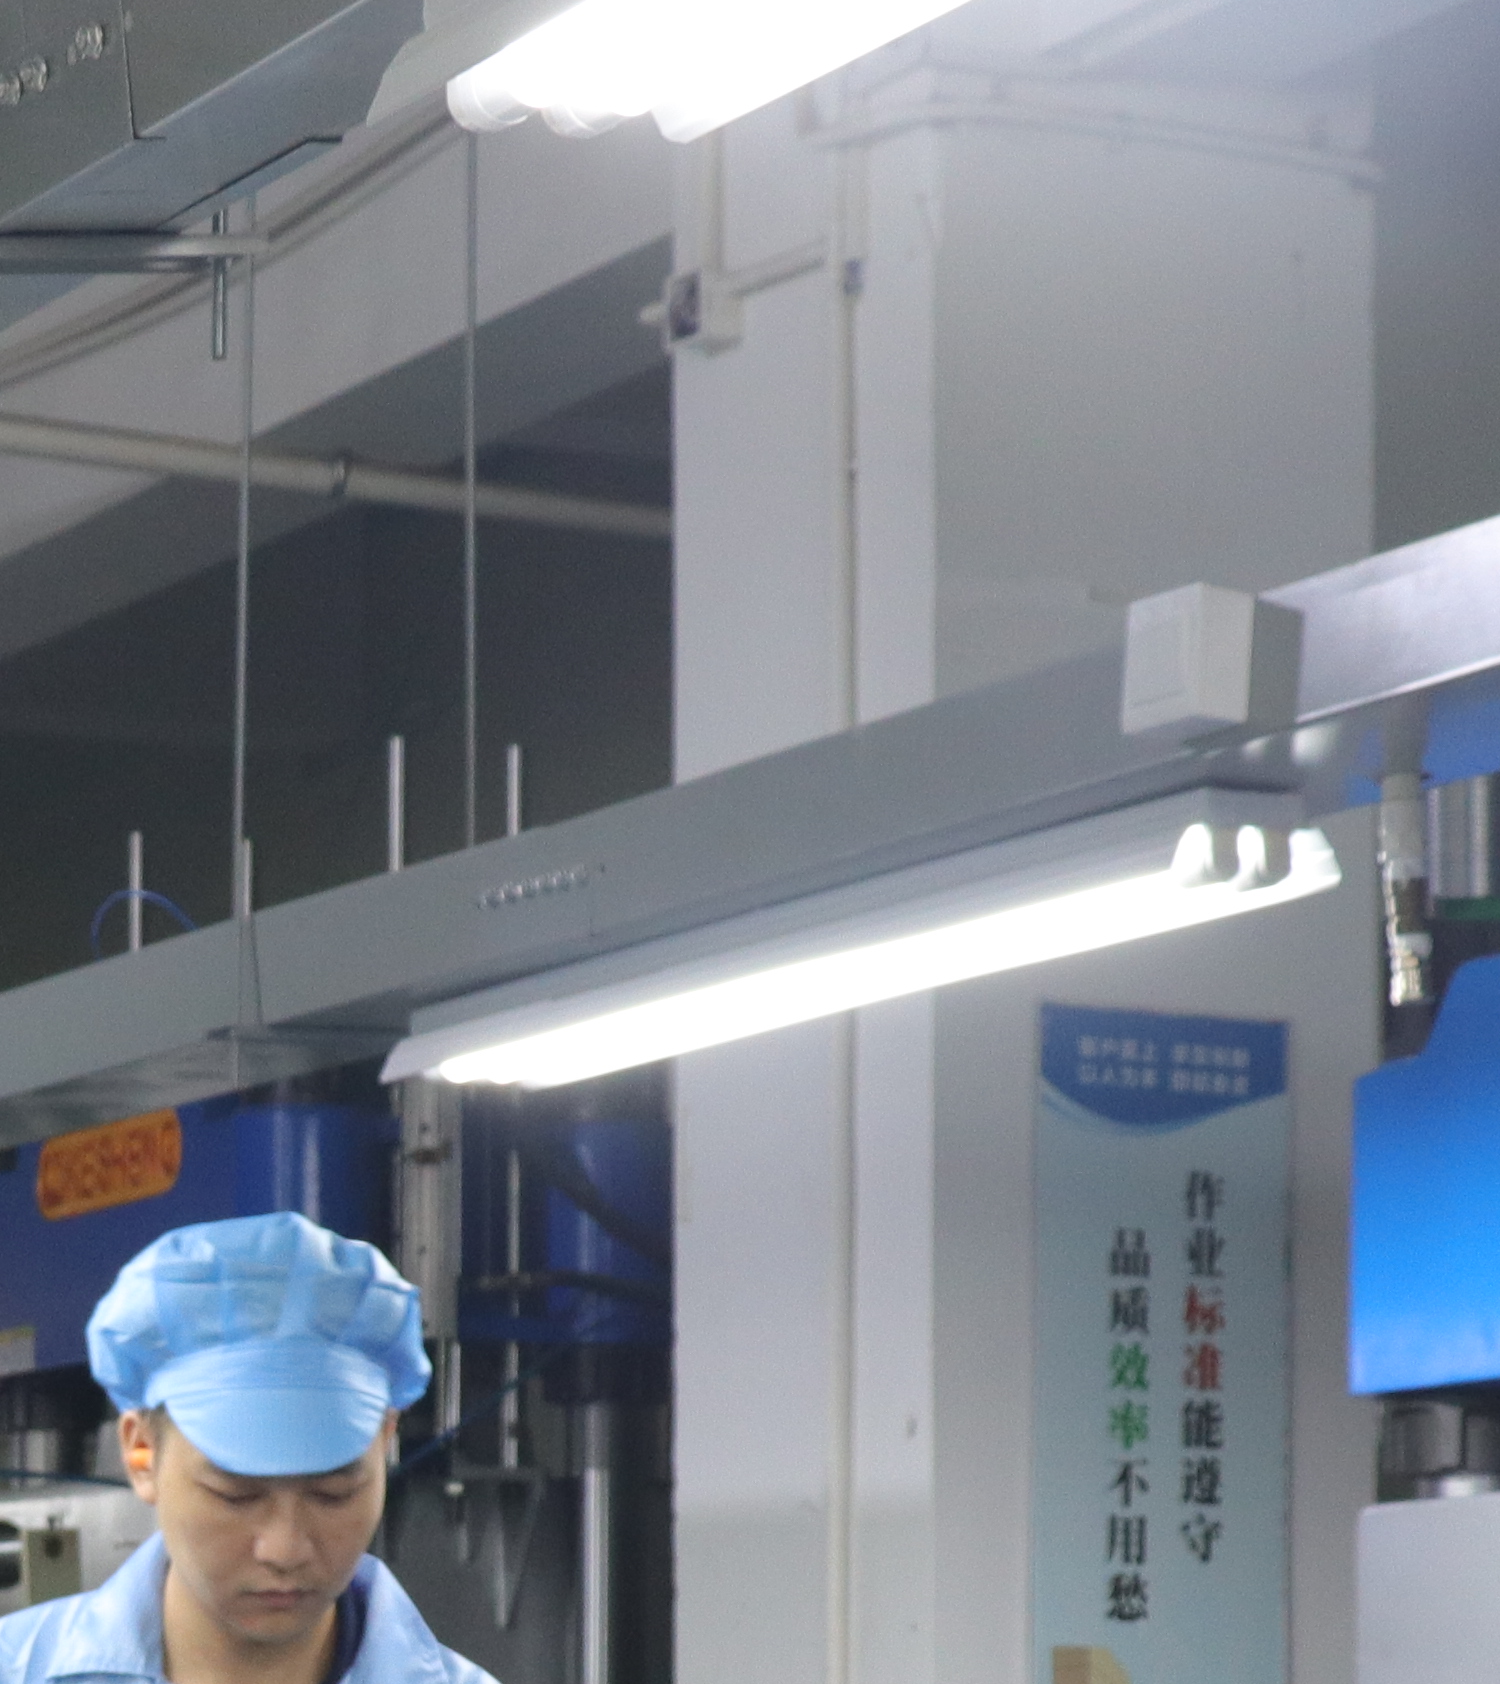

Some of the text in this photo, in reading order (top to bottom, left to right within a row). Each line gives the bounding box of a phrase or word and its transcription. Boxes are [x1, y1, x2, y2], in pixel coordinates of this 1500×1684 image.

[1106, 1226, 1149, 1622] 品质效率不用愁
[1182, 1169, 1226, 1564] 作业标准能遵守
